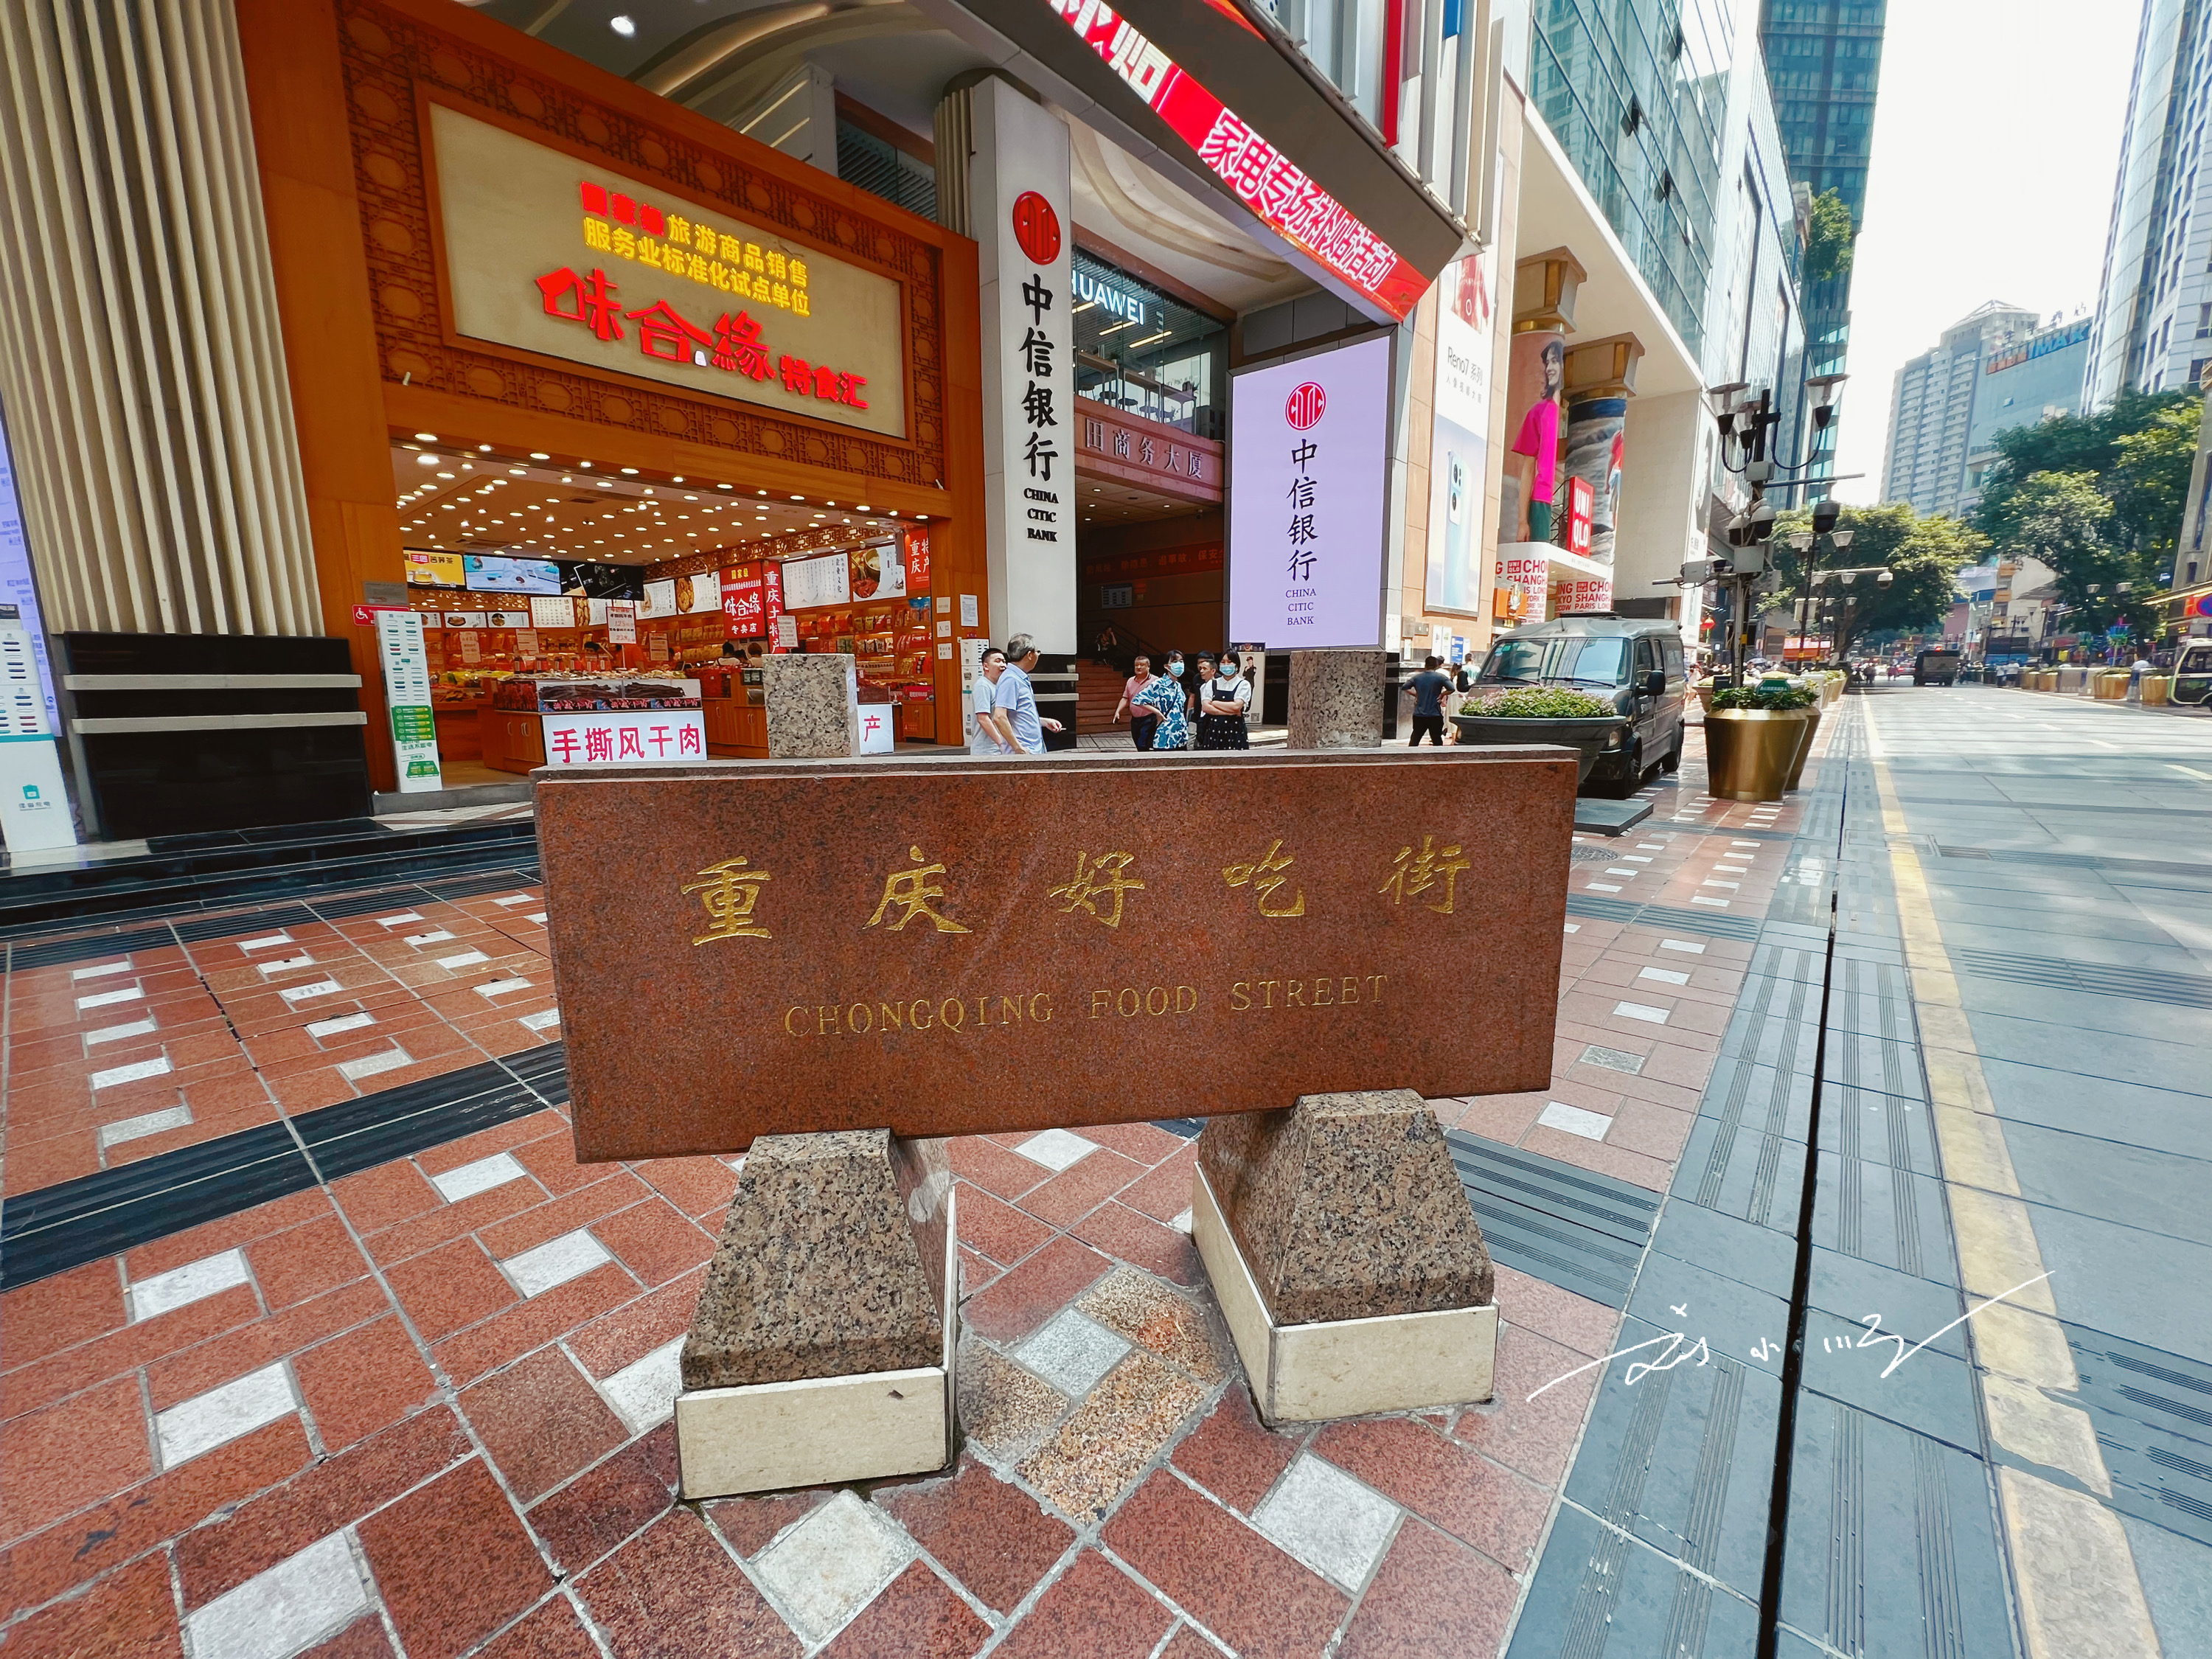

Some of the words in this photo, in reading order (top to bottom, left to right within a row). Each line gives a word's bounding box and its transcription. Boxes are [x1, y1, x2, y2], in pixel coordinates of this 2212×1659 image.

[1197, 107, 1397, 292] 家电专场补贴活动
[584, 216, 810, 317] 服务业标准化试点单位
[534, 267, 776, 382] 味合缘
[1447, 347, 1470, 375] Reno7
[1019, 274, 1058, 481] 中信银行
[1023, 487, 1060, 504] CHINA
[1286, 439, 1318, 581] 中信银行
[1575, 487, 1590, 518] UNI
[1027, 507, 1057, 523] CITIC
[1027, 526, 1057, 543] BANK
[1573, 519, 1589, 549] QLO
[909, 540, 922, 574] 重庆
[724, 591, 762, 616] 味合缘
[1285, 588, 1317, 598] CHINA
[1287, 602, 1314, 612] CITIC
[731, 622, 757, 635] 专卖店
[1287, 616, 1315, 626] BANK
[552, 723, 700, 763] 手撕风干肉
[864, 715, 881, 742] 产
[680, 837, 1471, 947] 重庆好吃街
[784, 990, 1055, 1039] CHONGQING
[1088, 985, 1200, 1020] FOOD
[1229, 974, 1391, 1013] STREET
